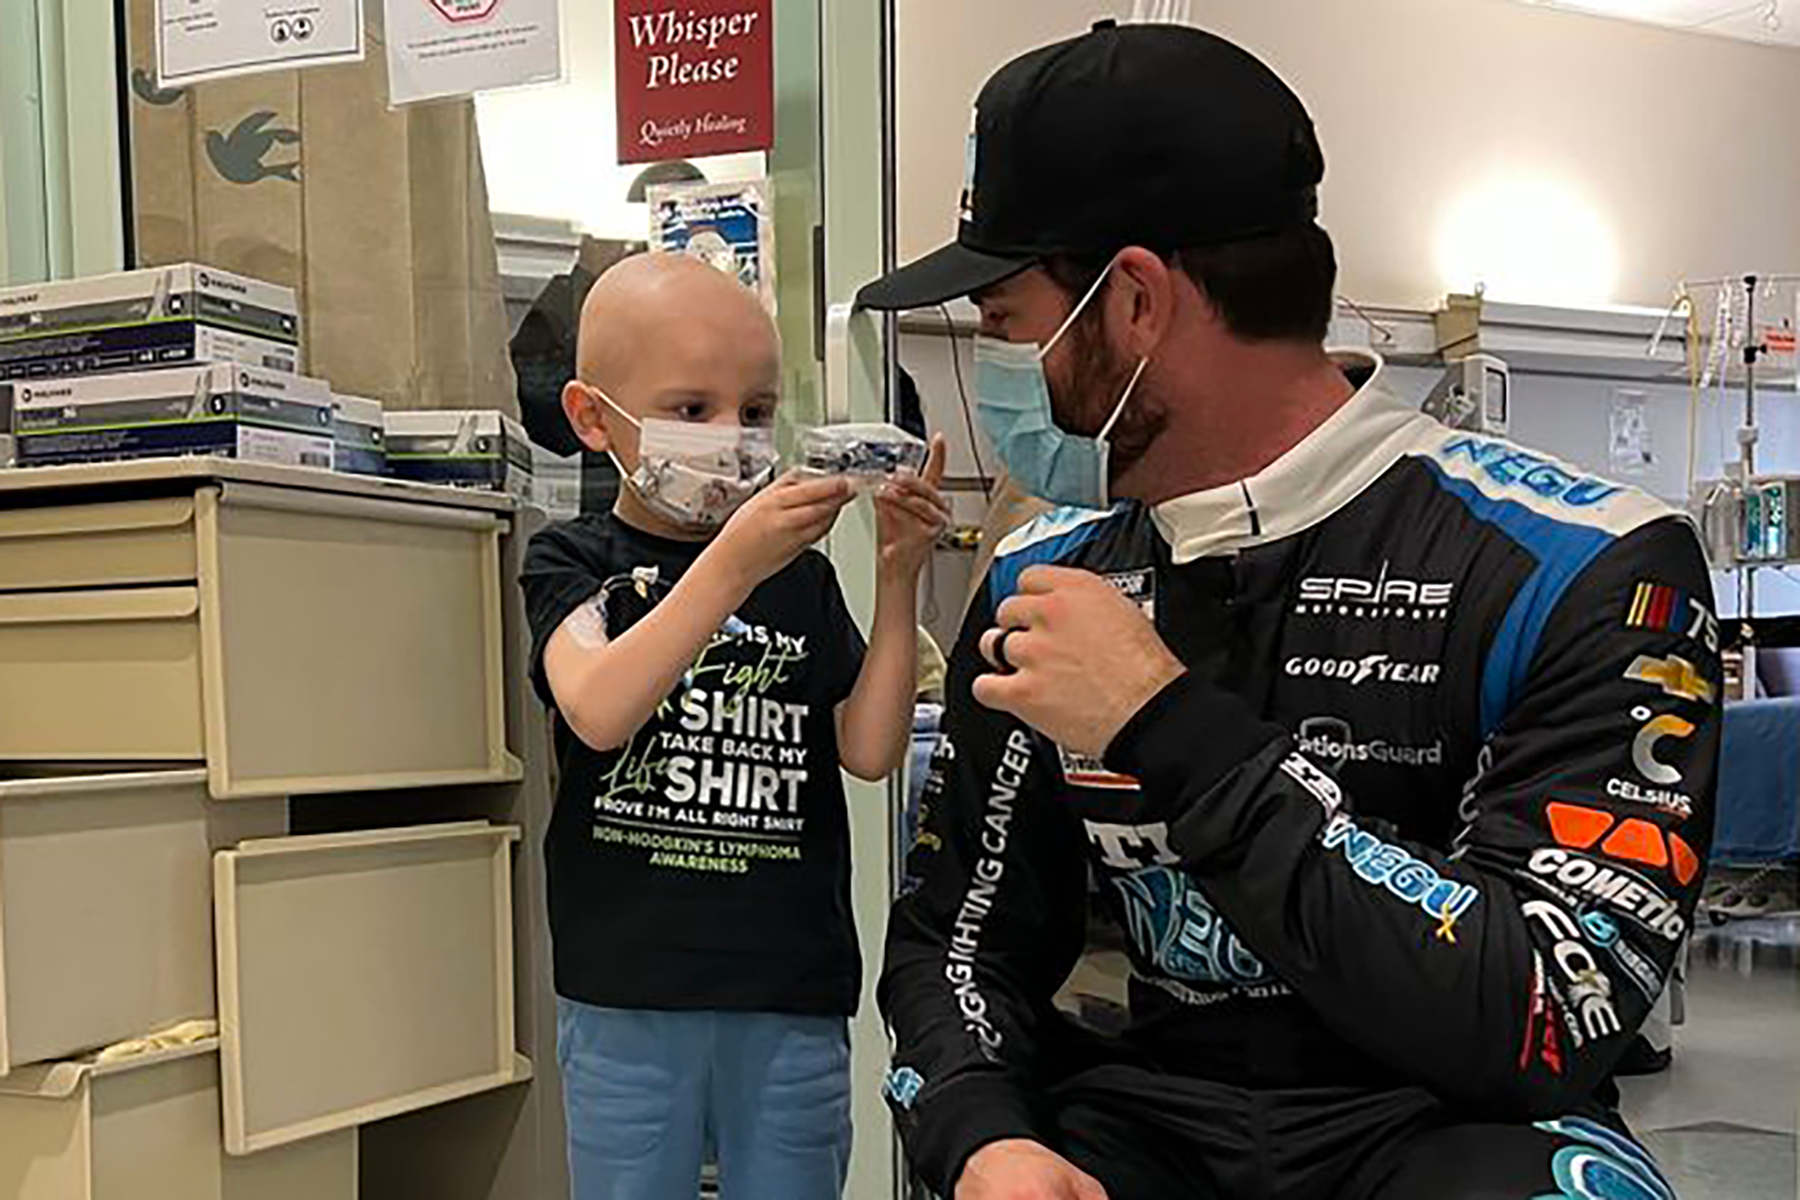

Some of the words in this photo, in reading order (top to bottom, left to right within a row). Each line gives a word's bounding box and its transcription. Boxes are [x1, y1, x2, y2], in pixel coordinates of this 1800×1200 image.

[628, 10, 758, 50] Whisper
[646, 53, 739, 89] Please
[1442, 438, 1624, 506] NEGU
[746, 625, 769, 644] IS
[775, 631, 806, 654] MY
[679, 688, 809, 743] SHIRT
[660, 731, 715, 754] TAKE
[722, 738, 774, 762] BACK
[779, 747, 807, 766] MY
[1292, 732, 1442, 765] ationsGuard
[664, 755, 808, 813] SHIRT
[981, 729, 1032, 854] CANCER
[1606, 777, 1693, 815] CELSIUS
[674, 808, 708, 825] ALL
[712, 811, 759, 829] RIGHT
[763, 815, 805, 832] SHIRT
[649, 851, 749, 874] AWARENESS
[719, 840, 801, 860] LYMPHOMA
[1322, 815, 1479, 920] NEGU
[1528, 849, 1686, 941] COMETIC
